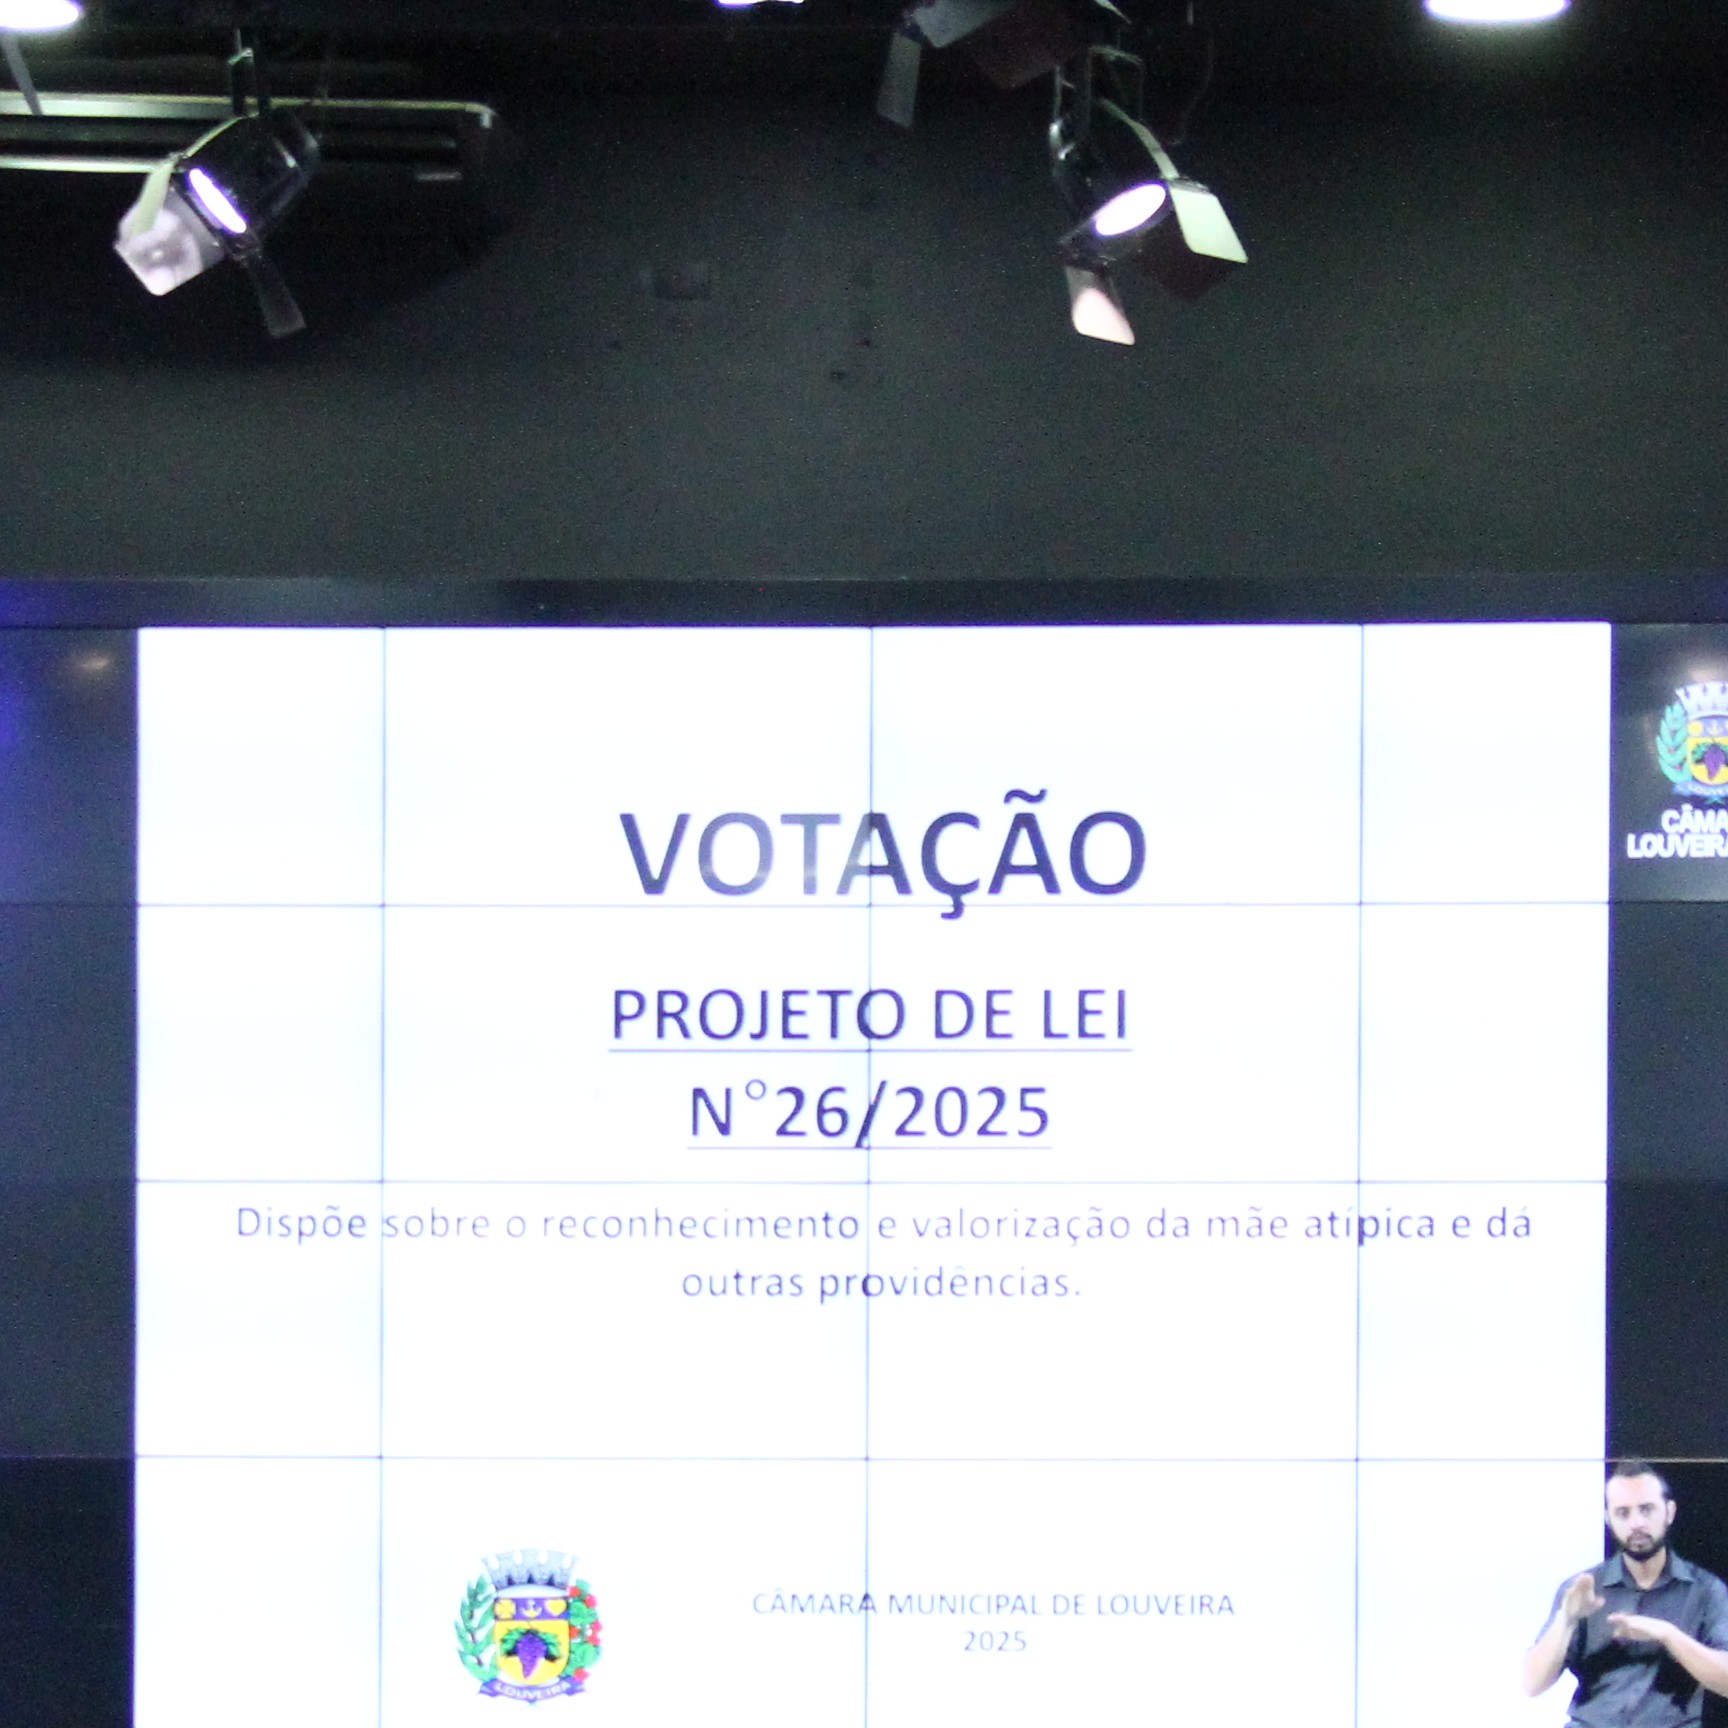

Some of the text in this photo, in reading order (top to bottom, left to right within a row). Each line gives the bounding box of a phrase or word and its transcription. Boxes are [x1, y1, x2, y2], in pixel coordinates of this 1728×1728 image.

[619, 788, 1147, 921] VOTAÇÃO
[612, 988, 1127, 1042] PROJETO DE LEI
[237, 1205, 1532, 1246] Dispõe sobre o reconhecimento e valorização da mãe atípica e dá
[682, 1265, 1081, 1303] outras providências.
[752, 1588, 1236, 1616] CÂMARA MUNICIPAL DE LOUVEIRA
[962, 1630, 1028, 1653] 2025
[493, 1680, 573, 1701] LOUVEIRA
